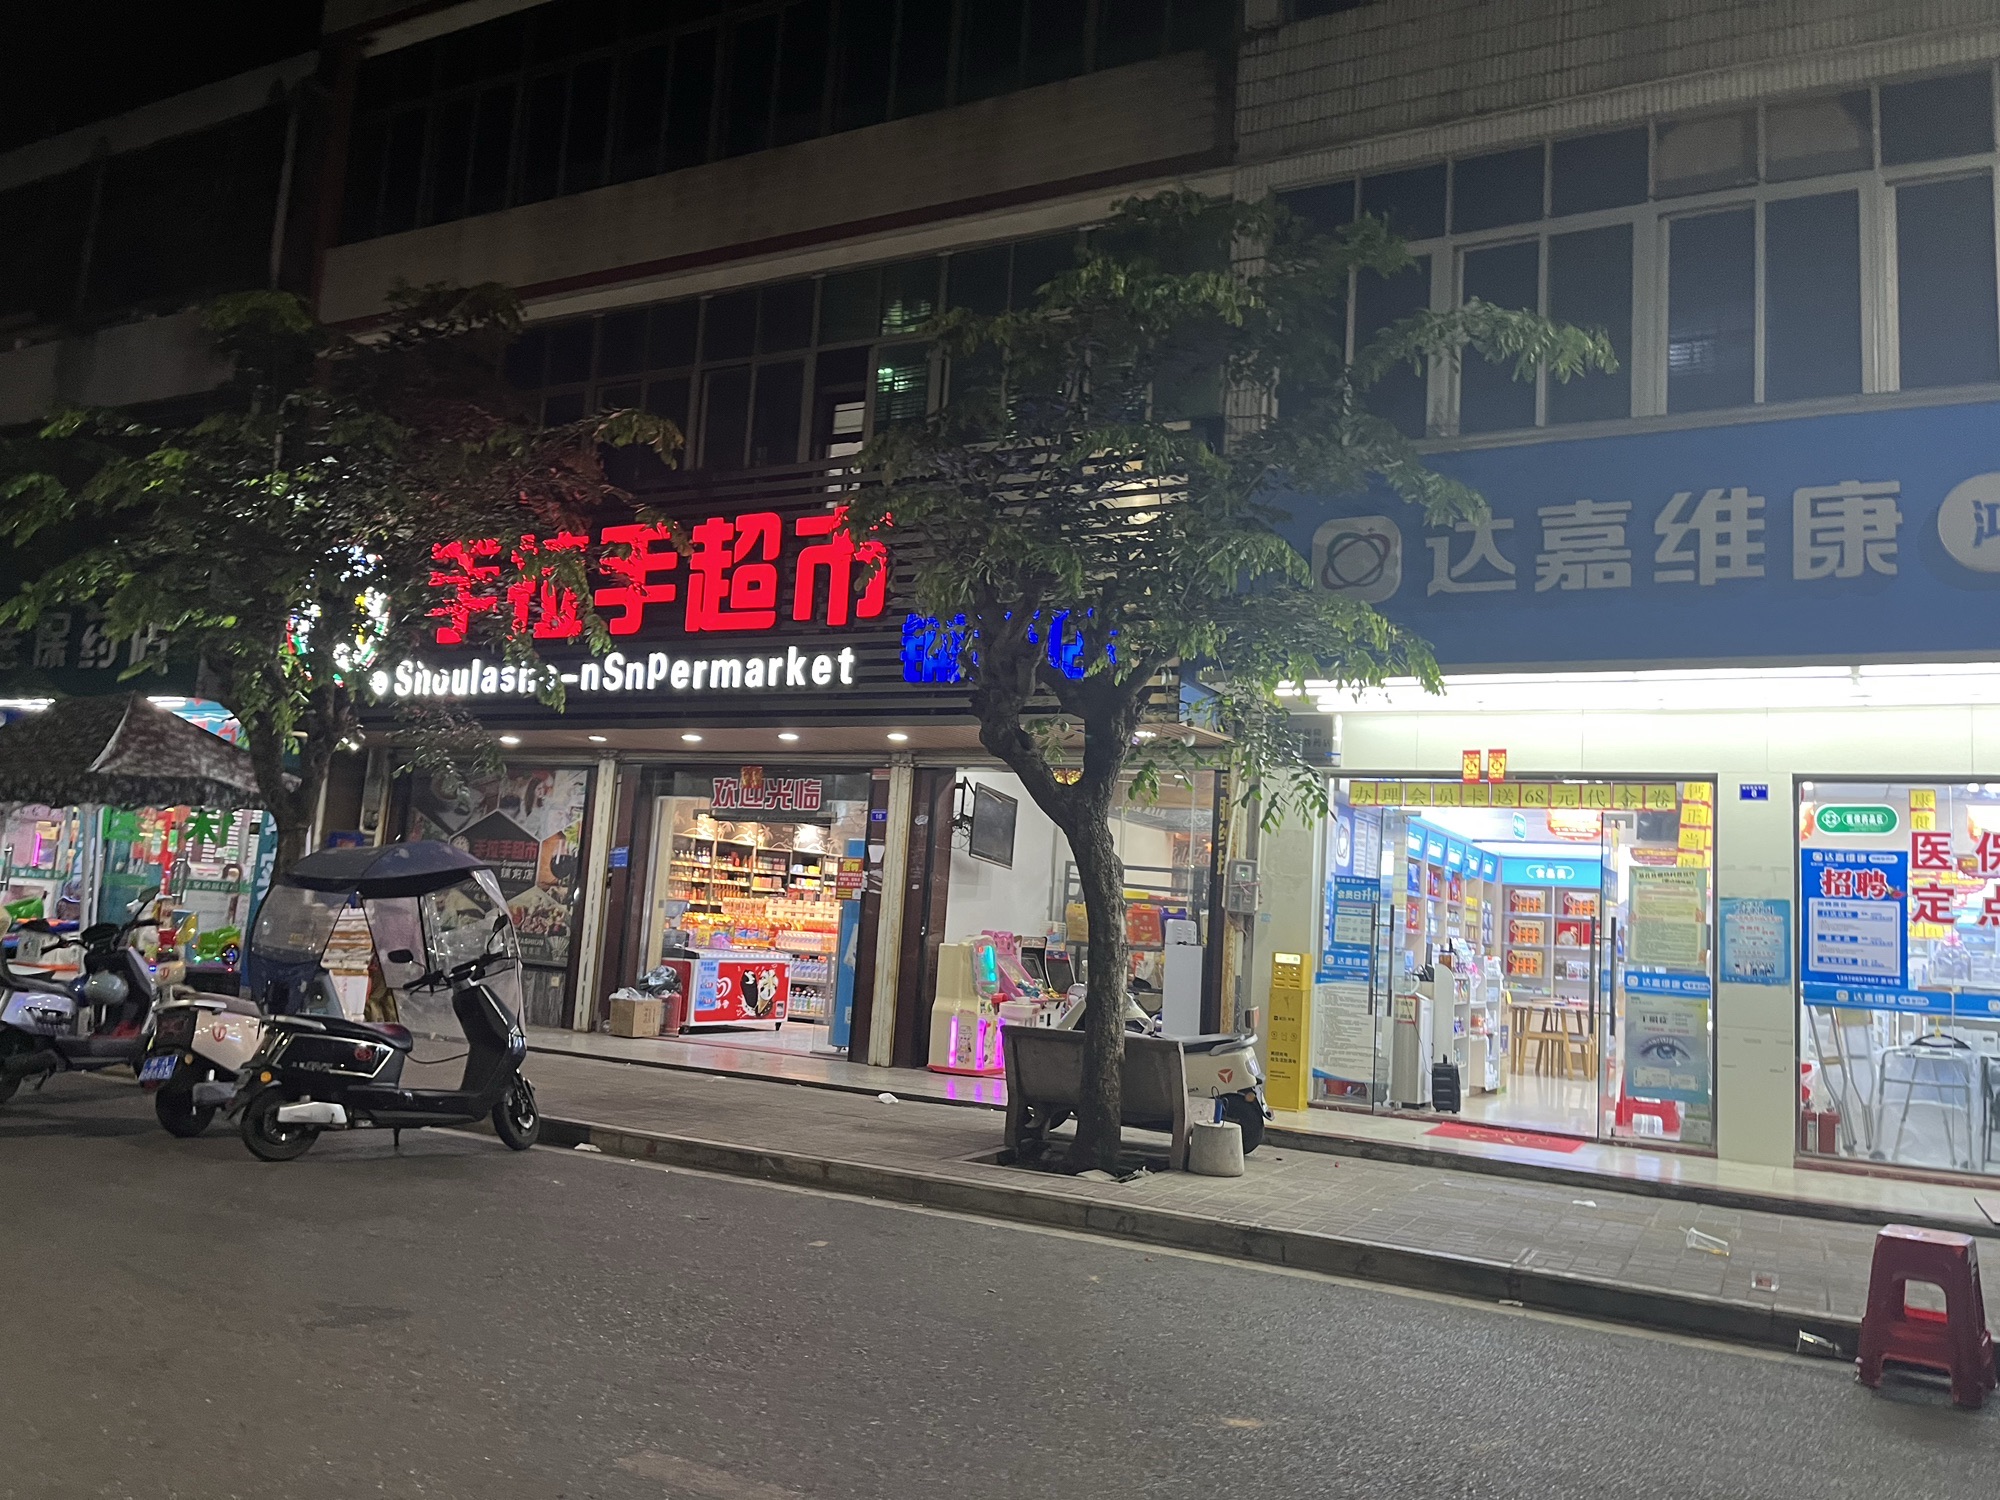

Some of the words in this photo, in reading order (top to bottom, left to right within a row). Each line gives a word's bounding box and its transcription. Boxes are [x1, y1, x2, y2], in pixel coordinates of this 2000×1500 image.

[1425, 481, 1902, 598] 达嘉维康
[711, 777, 822, 811] 欢迎光临
[1820, 867, 1889, 899] 招聘
